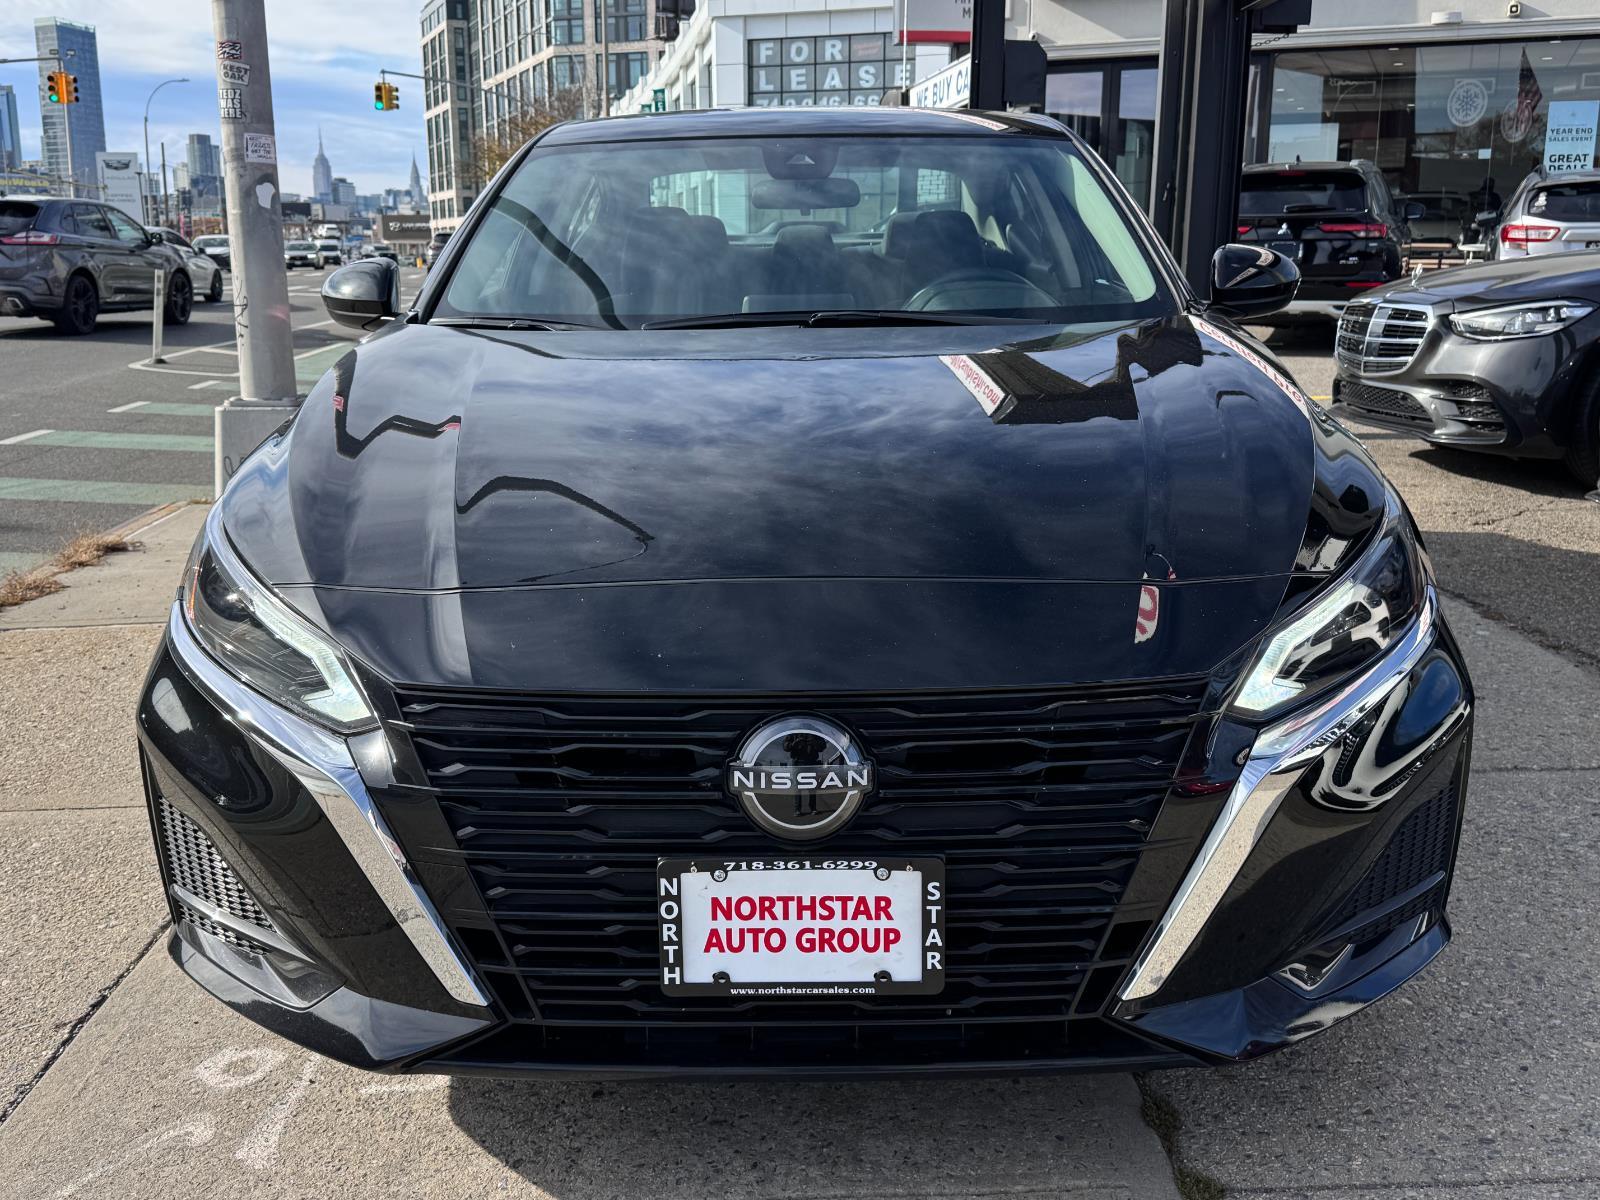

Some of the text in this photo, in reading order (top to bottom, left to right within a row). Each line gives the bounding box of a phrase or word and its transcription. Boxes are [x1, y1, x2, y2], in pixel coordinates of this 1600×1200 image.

[759, 40, 842, 64] FOR
[759, 64, 911, 91] LEASE
[917, 66, 969, 108] WE BUY CA
[1576, 127, 1593, 135] END
[1549, 153, 1589, 164] GREAT
[733, 769, 868, 789] NISSAN
[723, 860, 878, 871] 718-361-6299
[710, 895, 895, 921] NORTHSTAR
[660, 877, 681, 985] NORTH
[925, 881, 943, 970] STAR
[703, 927, 902, 953] AUTO GROUP
[730, 985, 876, 996] www.northstarcarsales.com
